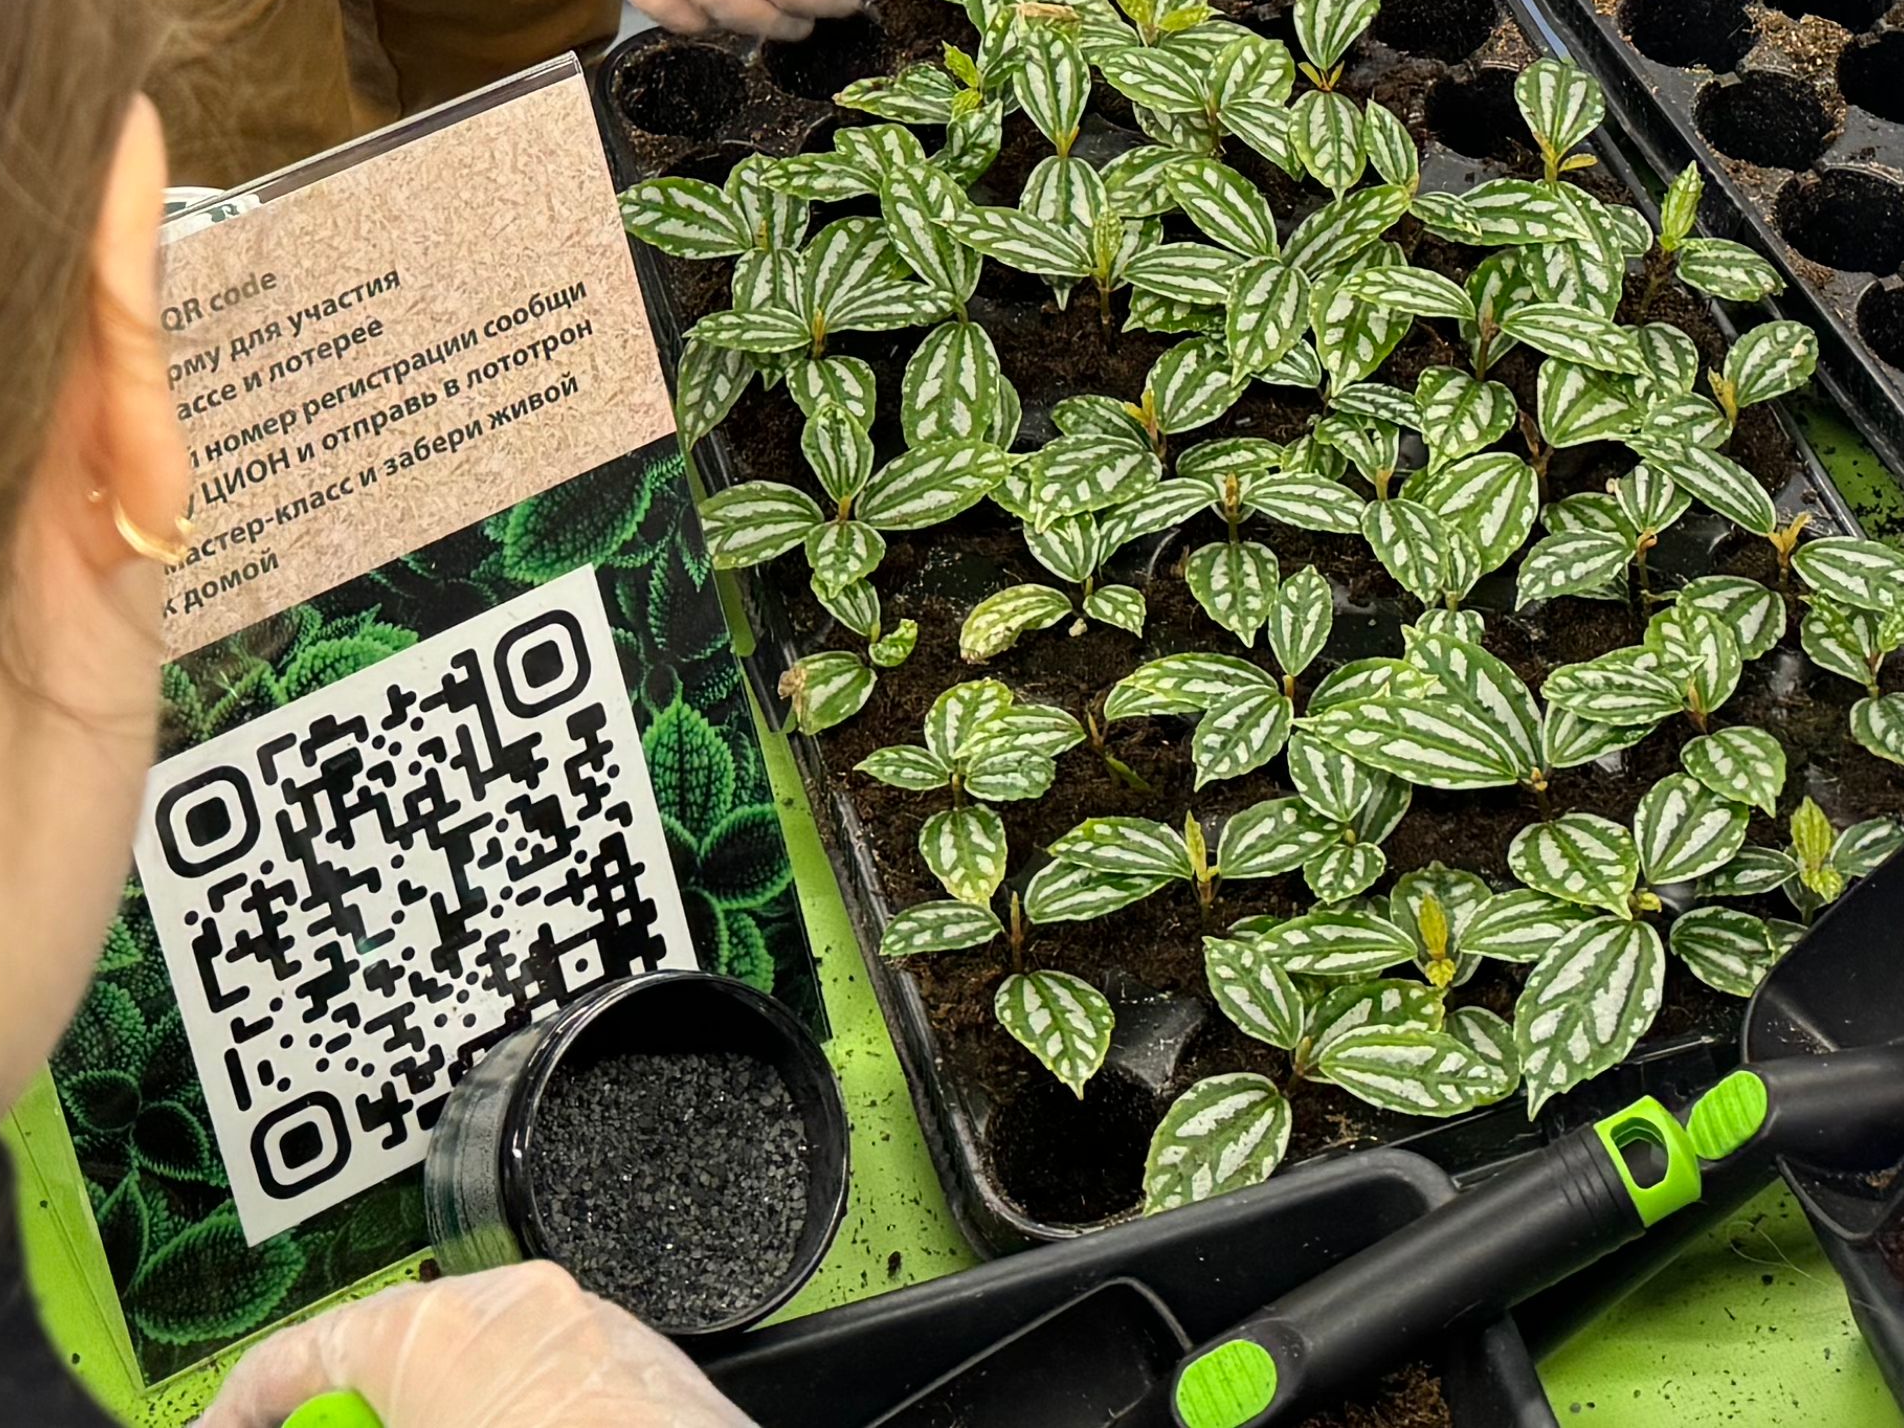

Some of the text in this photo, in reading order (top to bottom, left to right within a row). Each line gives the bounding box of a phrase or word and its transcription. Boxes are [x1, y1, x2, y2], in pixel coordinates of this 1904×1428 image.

[159, 271, 278, 332] QR code
[229, 320, 283, 362] для
[287, 269, 402, 338] участия
[204, 408, 298, 462] номер
[301, 328, 480, 426] регистрации
[482, 281, 588, 339] сообщи
[242, 370, 264, 394] и
[268, 318, 384, 383] лотерее
[200, 446, 292, 506] ЦИОН
[296, 441, 316, 464] и
[321, 390, 438, 452] отправь
[442, 377, 461, 399] в
[465, 318, 594, 390] лототрон
[358, 466, 379, 489] и
[382, 418, 484, 477] забери
[487, 370, 580, 431] живой
[183, 546, 280, 615] домой
